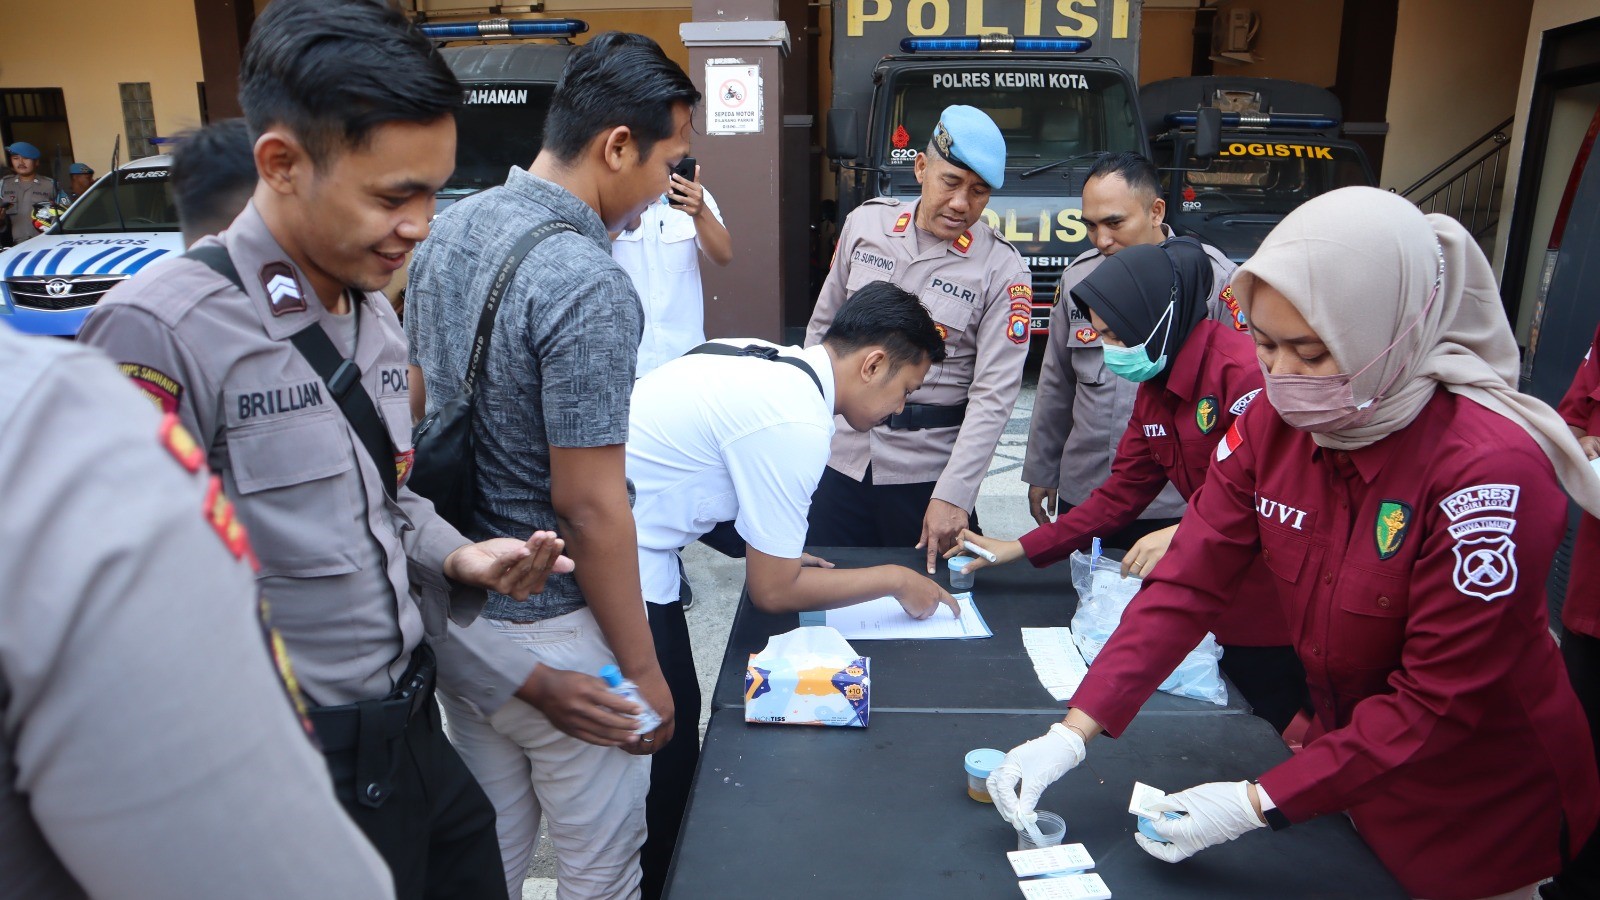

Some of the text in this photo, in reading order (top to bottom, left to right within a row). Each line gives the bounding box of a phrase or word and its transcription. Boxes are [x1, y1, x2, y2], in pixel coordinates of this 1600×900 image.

[847, 0, 1129, 38] POLISI
[933, 73, 1089, 89] POLRES KEDIRI KOTA
[891, 149, 918, 158] G20
[125, 171, 168, 179] POLRES
[56, 239, 150, 247] PROVOS
[861, 253, 894, 271] SURYONO
[931, 278, 978, 303] POLRI
[238, 382, 322, 419] BRILLIAN
[1446, 488, 1511, 513] POLRES
[1454, 499, 1509, 515] KEDIRI KOTA
